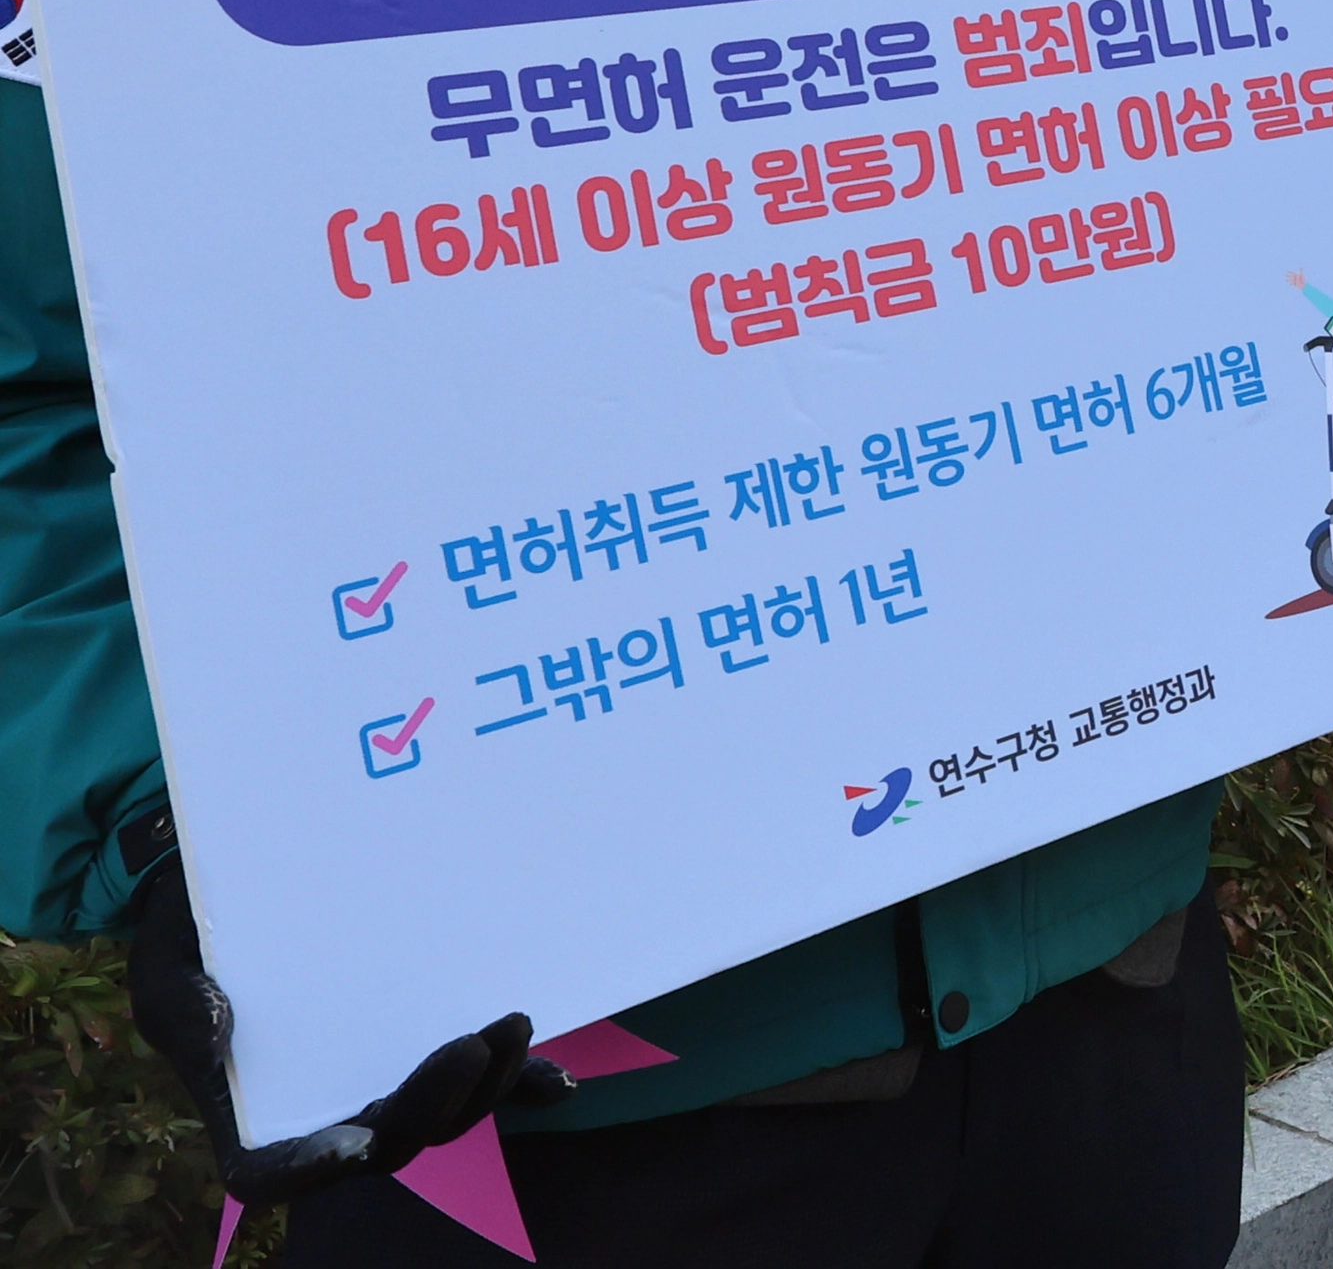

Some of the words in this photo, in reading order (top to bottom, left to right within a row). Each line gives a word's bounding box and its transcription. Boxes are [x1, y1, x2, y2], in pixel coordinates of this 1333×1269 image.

[427, 47, 693, 158] 무면허
[711, 21, 939, 122] 운전은
[328, 184, 559, 299] (16세
[577, 158, 733, 252] 이상
[752, 125, 964, 224] 원동기
[977, 103, 1105, 187] 면허
[1117, 83, 1232, 160] 이상
[690, 238, 938, 355] (범칙금
[952, 191, 1176, 294] 10만원)
[441, 478, 711, 609] 면허취득
[724, 447, 845, 530] 제한
[860, 402, 1023, 500] 원동기
[1031, 372, 1135, 454] 면허
[1146, 341, 1268, 421] 6개월
[471, 615, 687, 738] 그밖의
[699, 575, 826, 677] 면허
[838, 548, 929, 630] 1년
[927, 720, 1061, 800] 연수구청
[1068, 664, 1217, 751] 교통행정과
